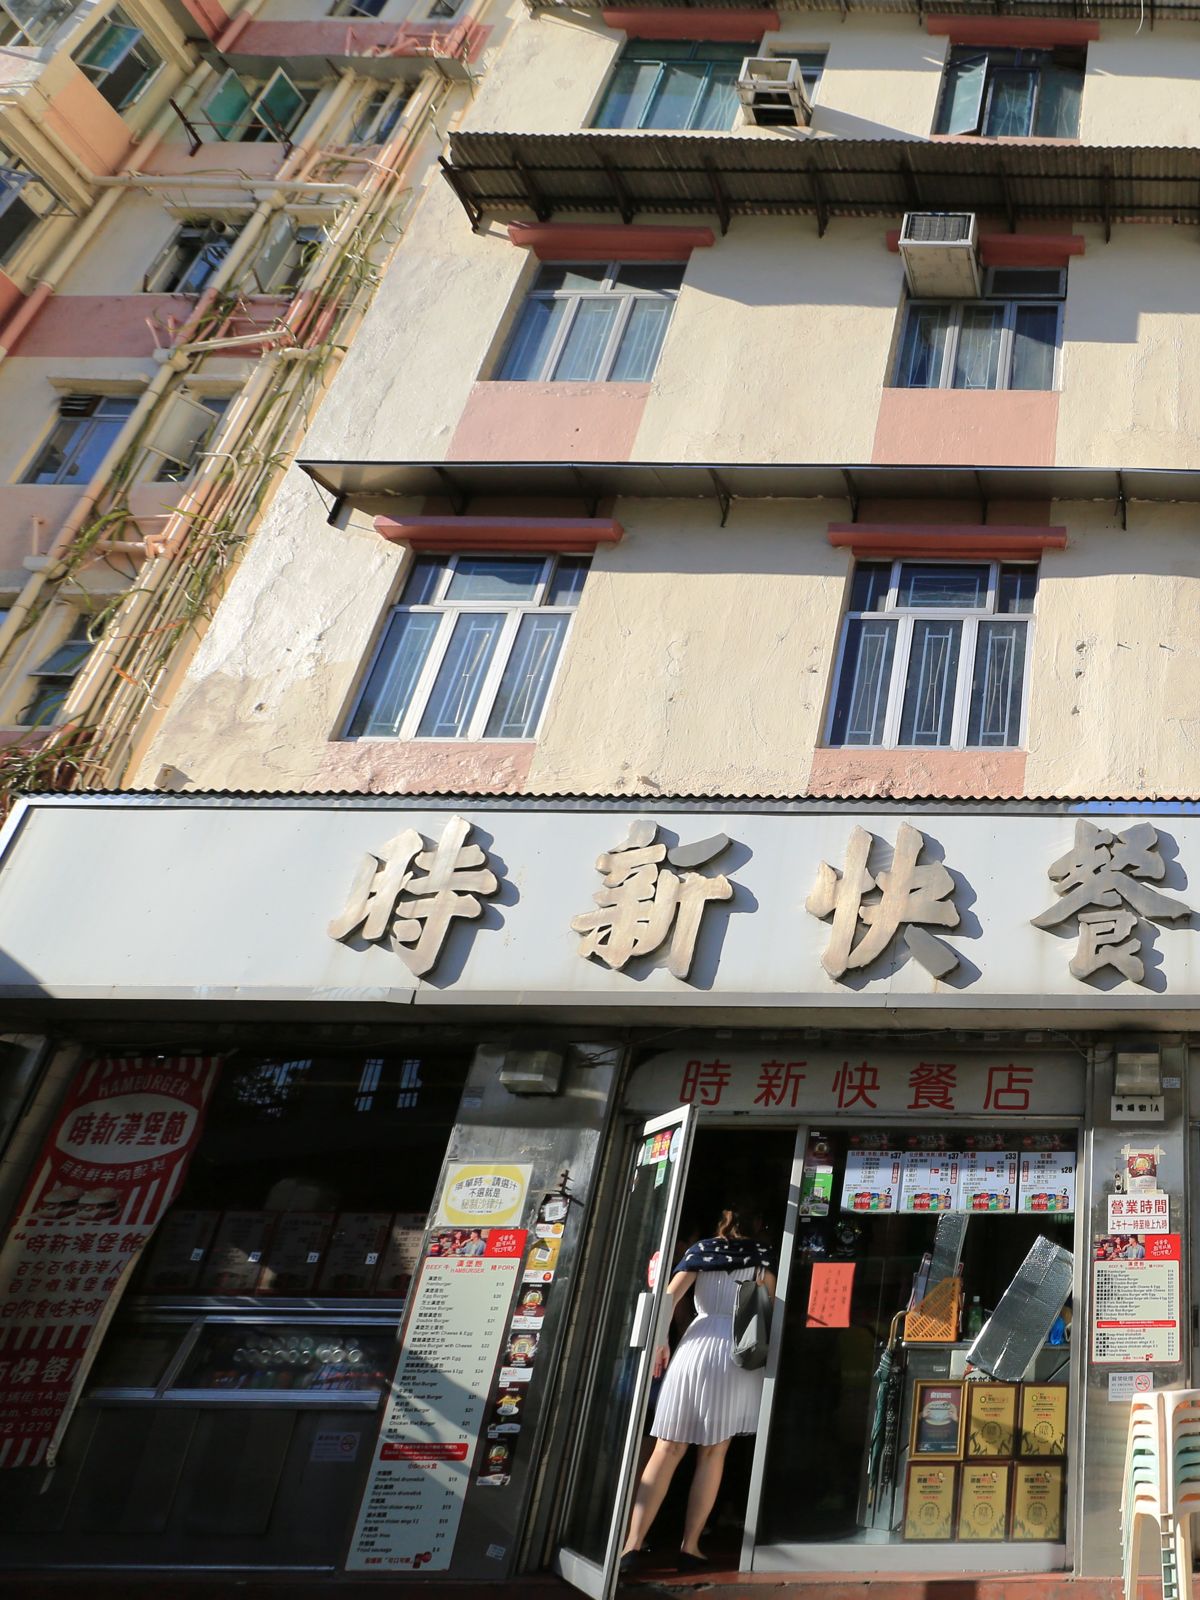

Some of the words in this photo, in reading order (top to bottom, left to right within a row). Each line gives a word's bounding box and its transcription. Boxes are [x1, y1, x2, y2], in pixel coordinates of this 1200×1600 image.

[98, 1074, 190, 1098] HAMBURGER
[680, 1058, 1035, 1111] 時新快餐店
[67, 1111, 189, 1146] 時新漢堡飽
[1111, 1199, 1167, 1214] 營業時間
